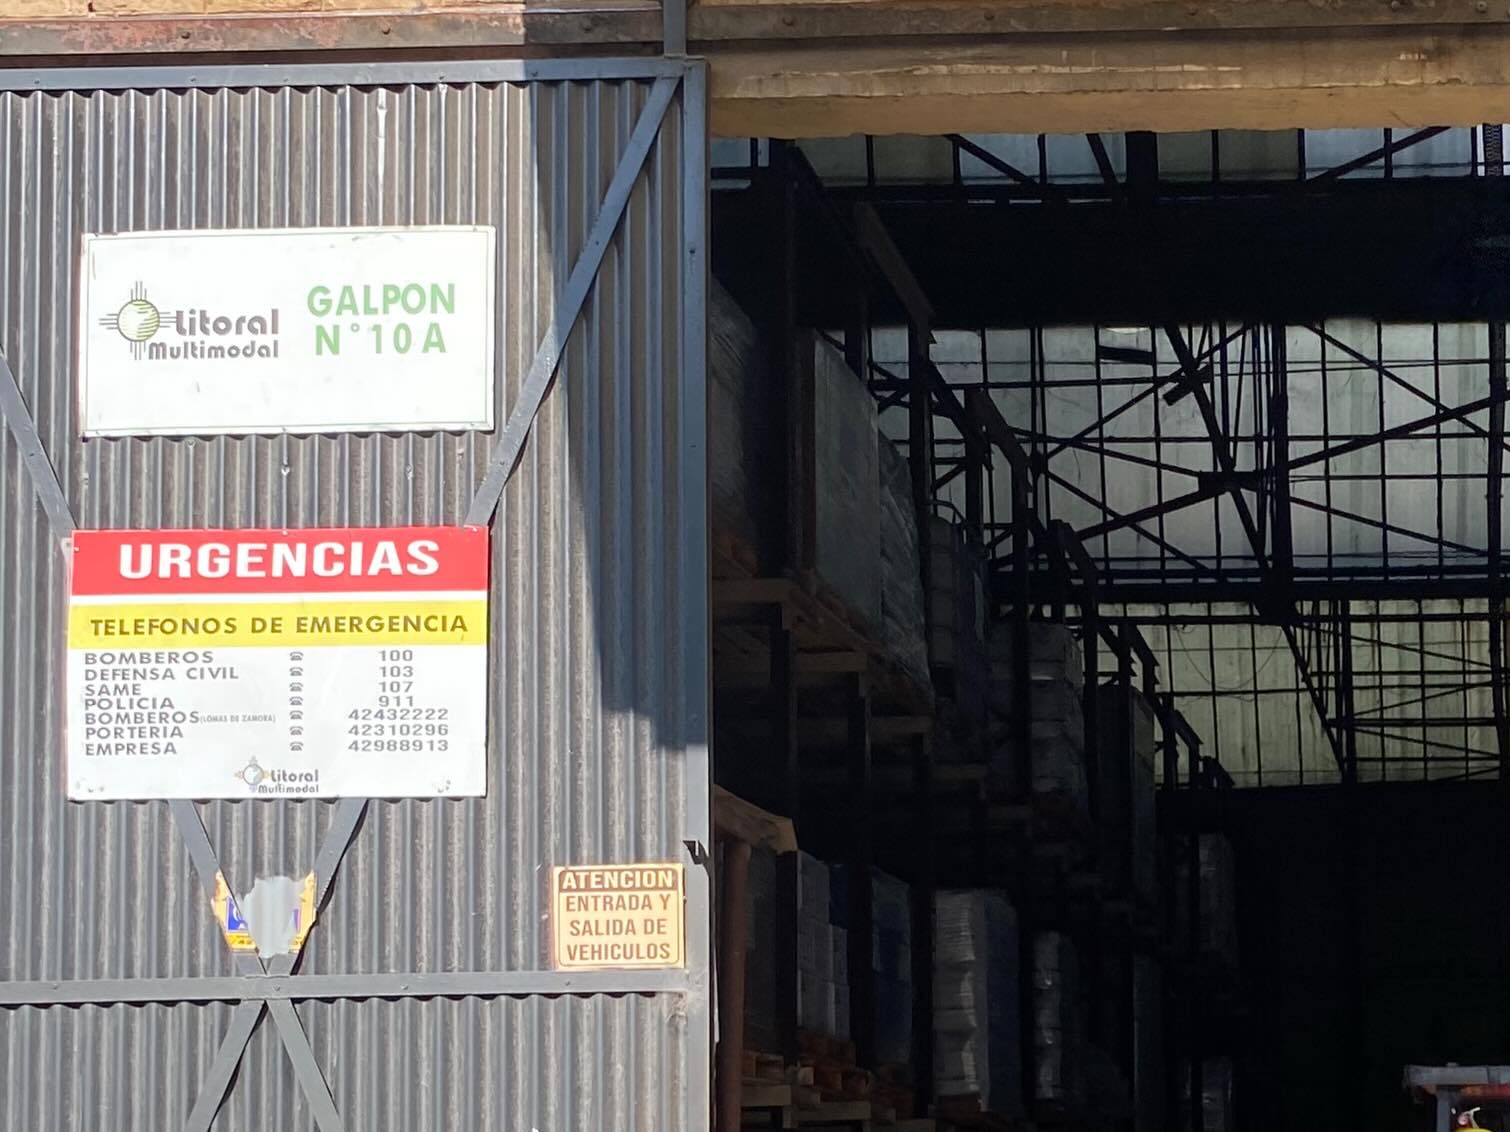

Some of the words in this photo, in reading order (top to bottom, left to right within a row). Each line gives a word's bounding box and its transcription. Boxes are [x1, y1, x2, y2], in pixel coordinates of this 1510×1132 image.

[307, 283, 455, 317] GALPON
[174, 308, 279, 337] Litoral
[148, 339, 279, 361] Multimodal
[118, 540, 440, 580] URGENCIAS
[91, 617, 238, 637] TELEFONOS
[251, 617, 283, 635] DE
[296, 614, 468, 634] EMERGENCIA
[84, 650, 214, 666] BOMBEROS
[378, 649, 414, 662] 100
[84, 667, 176, 682] DEFENSA
[186, 666, 240, 681] CIVIL
[378, 665, 414, 678] 103
[84, 683, 142, 697] SAME
[378, 681, 414, 693] 107
[84, 697, 175, 711] POLICIA
[378, 695, 414, 707] 911
[85, 711, 200, 725] BOMBEROS
[348, 708, 449, 721] 42432222
[85, 725, 184, 740] PORTERIA
[348, 724, 449, 736] 42310296
[85, 741, 177, 756] EMPRESA
[348, 739, 449, 752] 42988913
[270, 769, 319, 783] Litoral
[257, 784, 319, 794] Multimodal
[562, 870, 673, 890] ATENCION
[566, 894, 652, 912] ENTRADA
[659, 893, 671, 911] Y
[569, 919, 636, 937] SALIDA
[643, 918, 668, 935] DE
[566, 943, 671, 961] VEHICULOS
